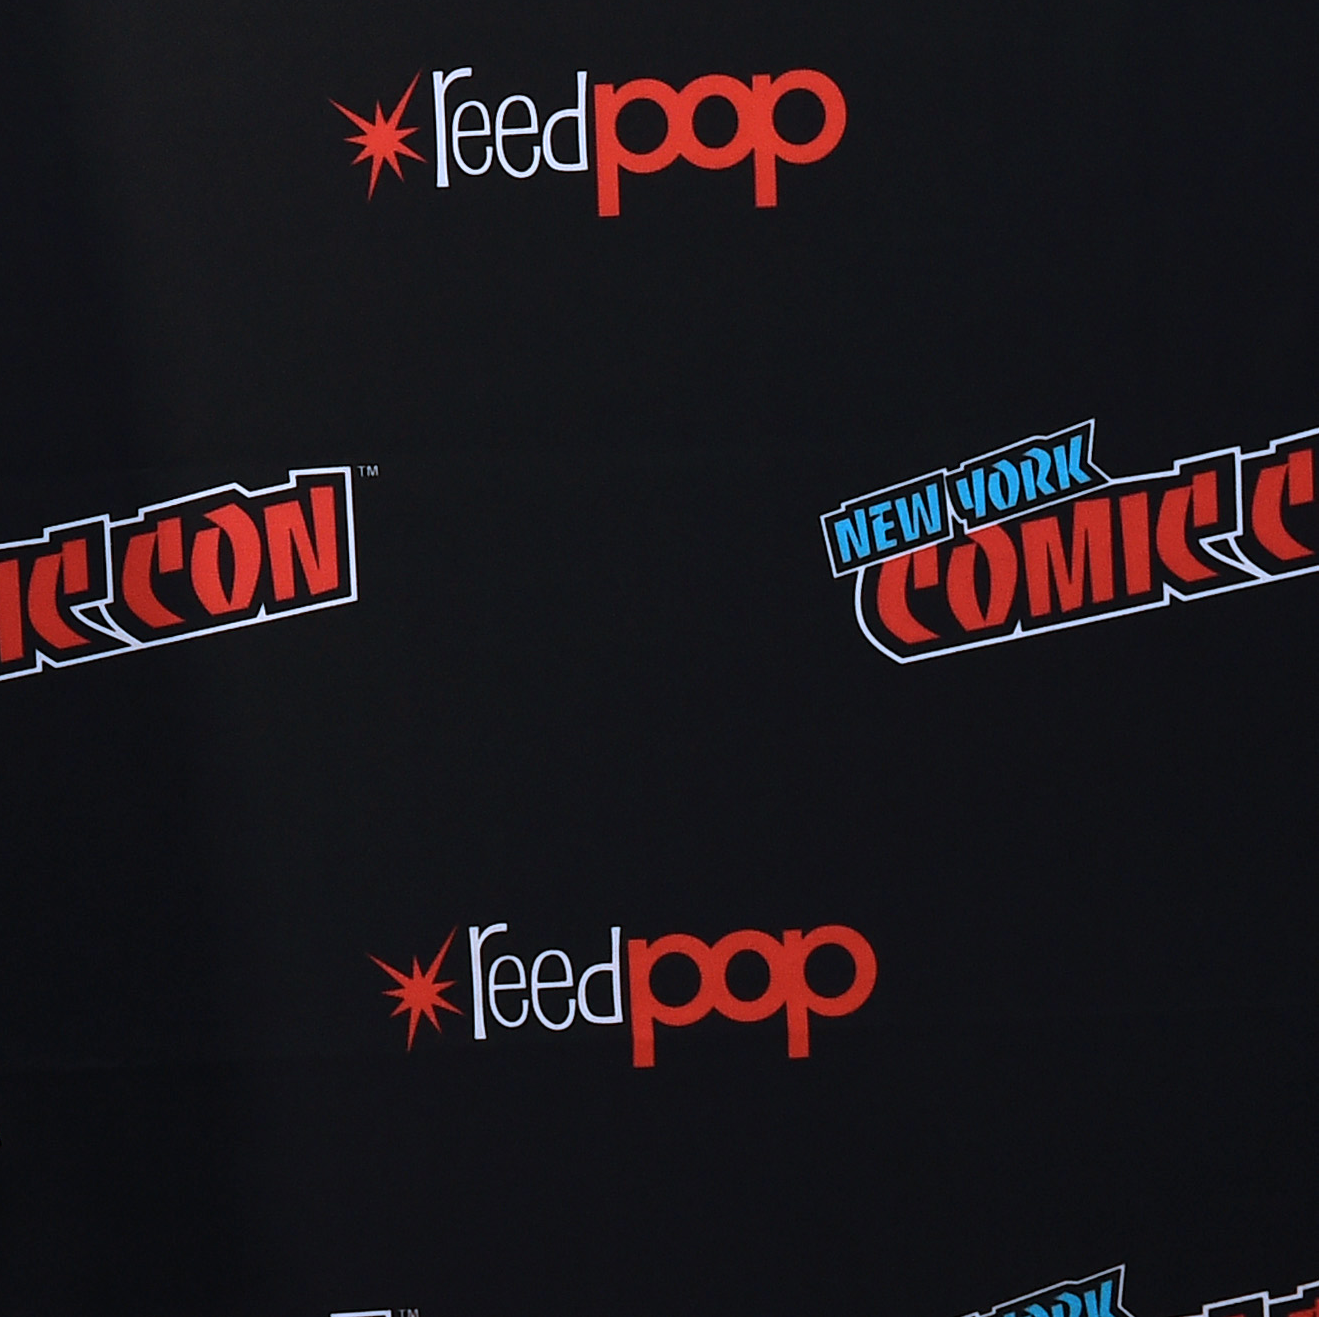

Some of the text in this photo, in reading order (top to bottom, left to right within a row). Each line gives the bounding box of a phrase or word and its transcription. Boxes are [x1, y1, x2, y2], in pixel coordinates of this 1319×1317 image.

[122, 485, 339, 628] CON
[833, 434, 1091, 563] NEW YORK
[877, 470, 1218, 644] COMIC
